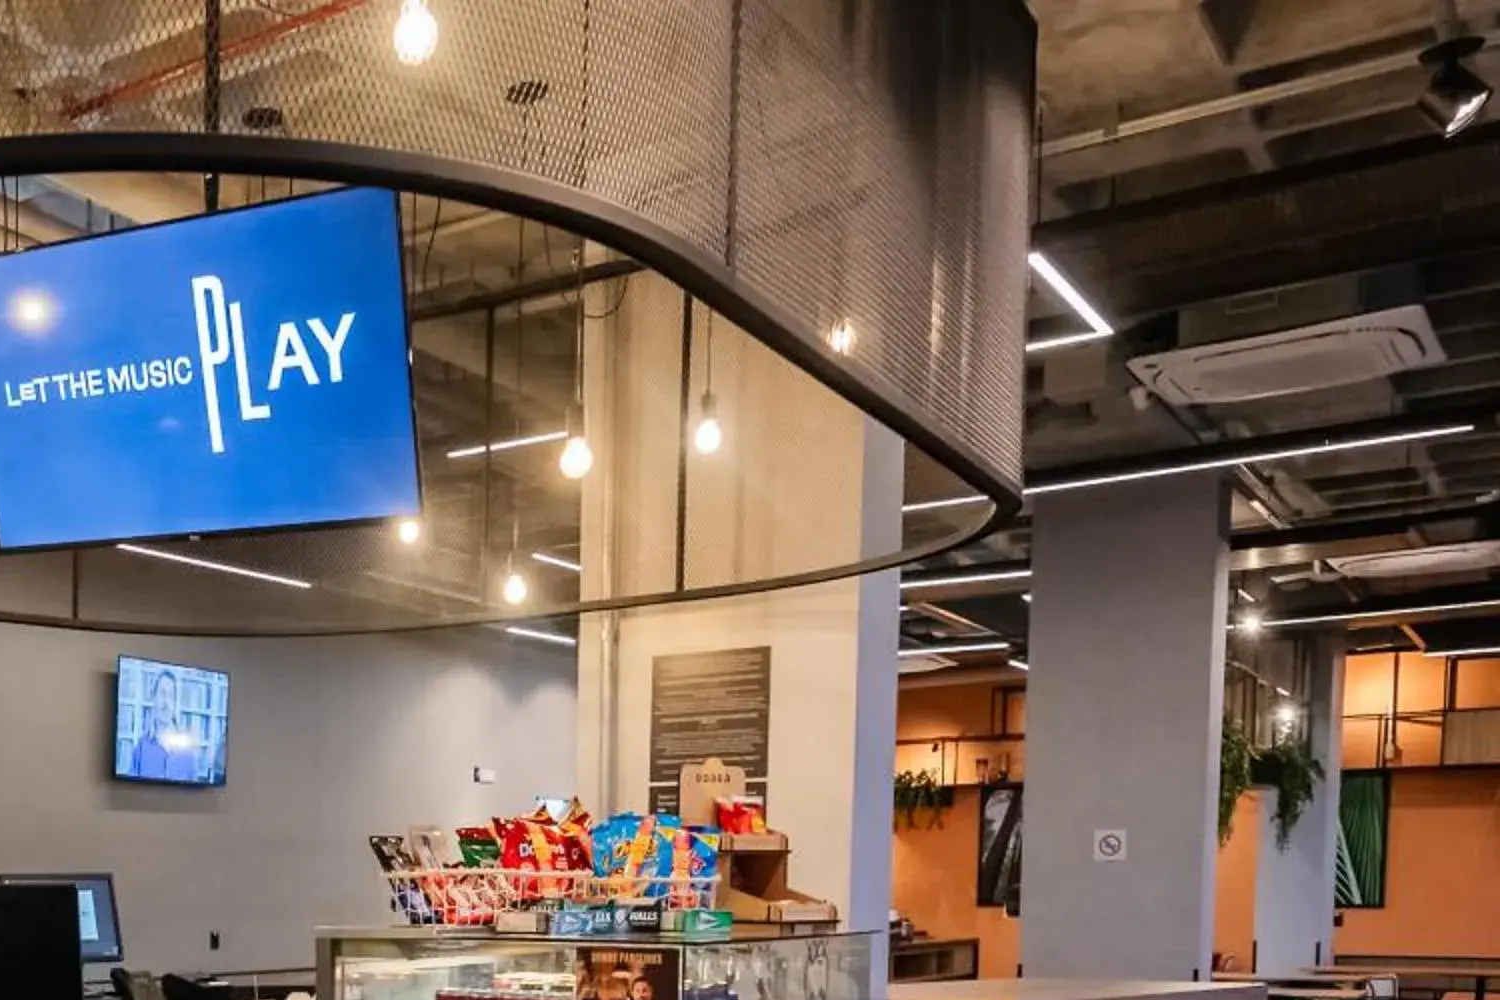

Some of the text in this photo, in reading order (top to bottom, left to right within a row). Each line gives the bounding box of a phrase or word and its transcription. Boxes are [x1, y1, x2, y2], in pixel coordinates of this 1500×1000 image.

[4, 273, 356, 453] LET THE MUSIC PLAY
